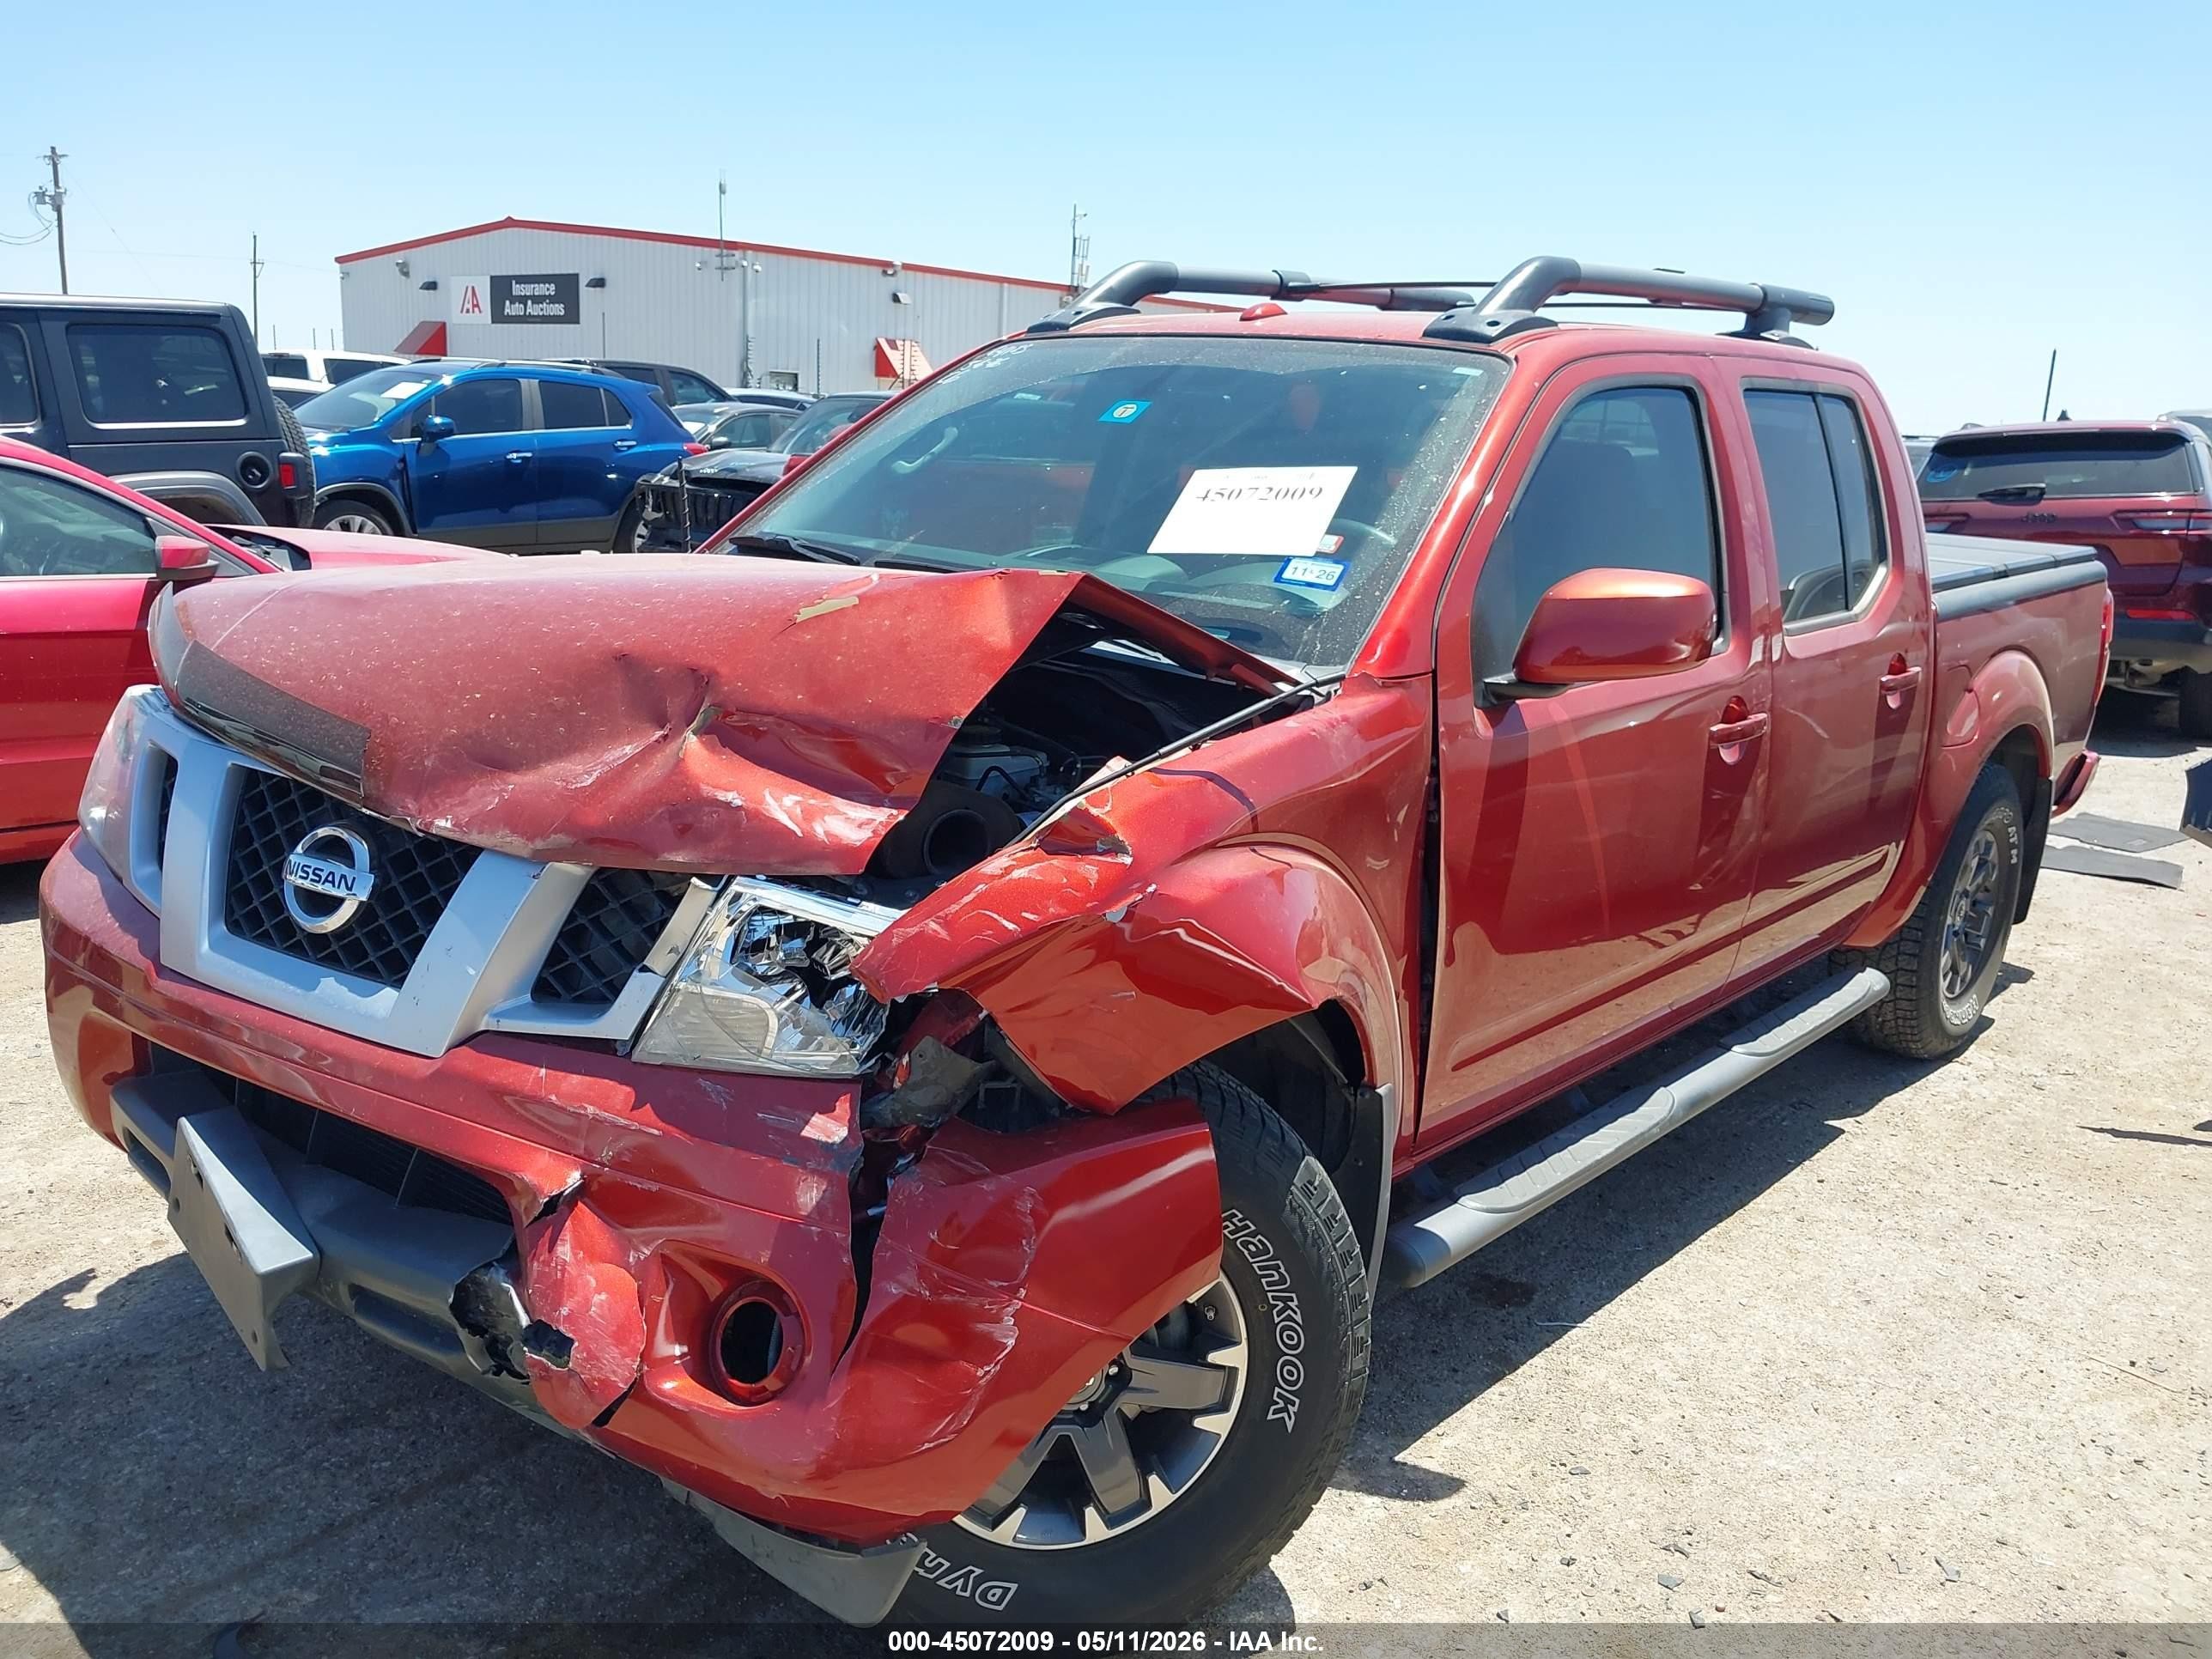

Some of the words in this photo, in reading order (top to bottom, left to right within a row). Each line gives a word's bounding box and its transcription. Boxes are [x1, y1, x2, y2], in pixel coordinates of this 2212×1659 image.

[512, 280, 556, 296] Insurance
[504, 300, 525, 316] Auto
[526, 299, 565, 316] Auctions
[1196, 487, 1323, 501] 45072009
[284, 858, 356, 892] NISSAN
[1222, 1209, 1305, 1434] Hankook
